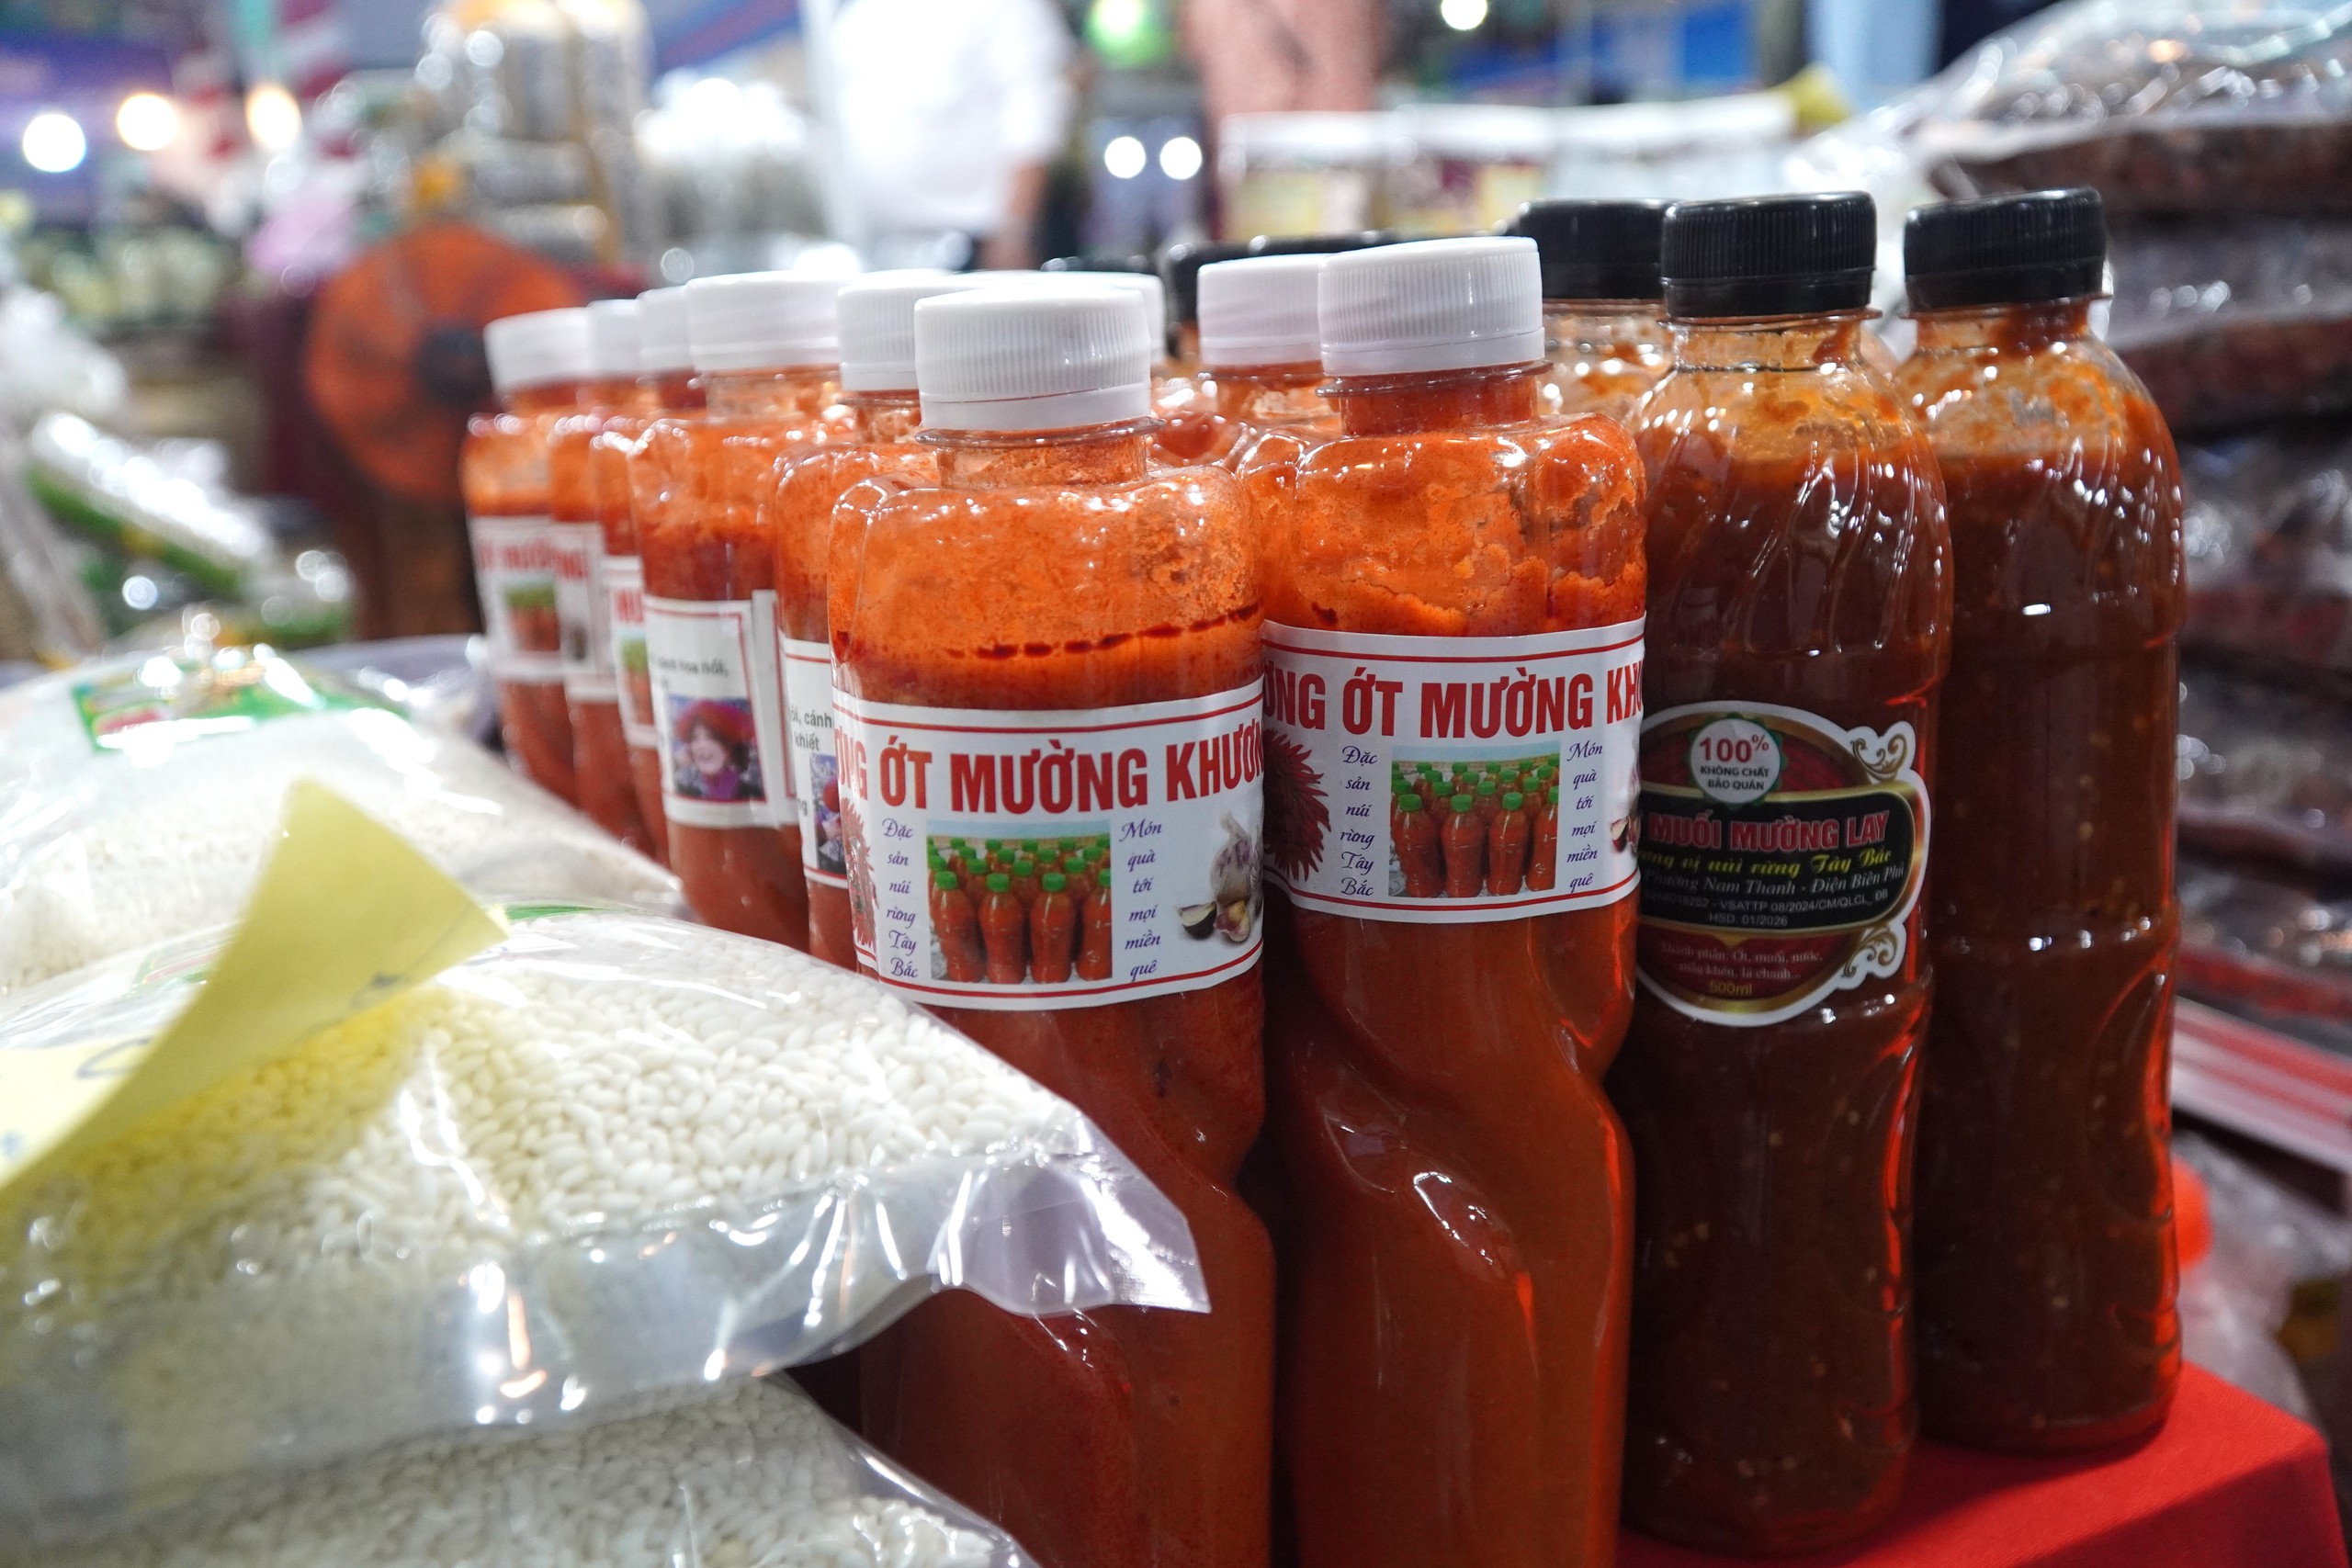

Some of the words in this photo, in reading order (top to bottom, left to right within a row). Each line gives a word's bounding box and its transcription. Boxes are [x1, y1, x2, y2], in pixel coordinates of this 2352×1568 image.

[1341, 666, 1403, 736] ỚT
[1419, 666, 1594, 739] MƯỜNG
[1341, 745, 1379, 767] Đặc
[1566, 740, 1604, 761] Món
[1700, 734, 1770, 764] 100%
[879, 735, 933, 809] ỚT
[950, 739, 1148, 814] MƯỜNG
[1572, 768, 1598, 789] quà
[1700, 765, 1739, 777] KHÔNG
[1742, 765, 1770, 777] CHẤT
[1345, 775, 1372, 792] sản
[1708, 778, 1731, 789] BẢO
[1733, 780, 1765, 790] QUẢN
[1345, 801, 1372, 818] núi
[1576, 794, 1594, 811] tới
[882, 818, 914, 840] Đặc
[1117, 819, 1163, 842] Món
[1339, 827, 1376, 850] rừng
[1571, 820, 1597, 839] mọi
[1648, 808, 1722, 849] MUỐI
[1730, 815, 1840, 853] MƯỜNG
[1846, 810, 1891, 848] LAY
[887, 852, 910, 867] sản
[1126, 849, 1157, 872] quà
[1340, 851, 1374, 875] Tây
[1566, 847, 1600, 865] miền
[1810, 853, 1853, 874] Tây
[1859, 846, 1893, 869] Bắc
[888, 879, 910, 896] núi
[1132, 875, 1154, 894] tới
[1340, 877, 1375, 897] Bắc
[1569, 874, 1594, 895] quê
[1703, 875, 1741, 893] Nam
[1745, 878, 1797, 896] Thanh
[1811, 875, 1848, 895] Điện
[886, 903, 917, 928] rừng
[1128, 904, 1158, 923] mọi
[1720, 899, 1769, 912] VSATTP
[1741, 914, 1789, 927] 01/2026
[888, 931, 917, 953] Tây
[1125, 932, 1162, 952] miền
[889, 957, 919, 979] Bắc
[1129, 959, 1159, 983] quê
[1709, 981, 1753, 996] 500ml
